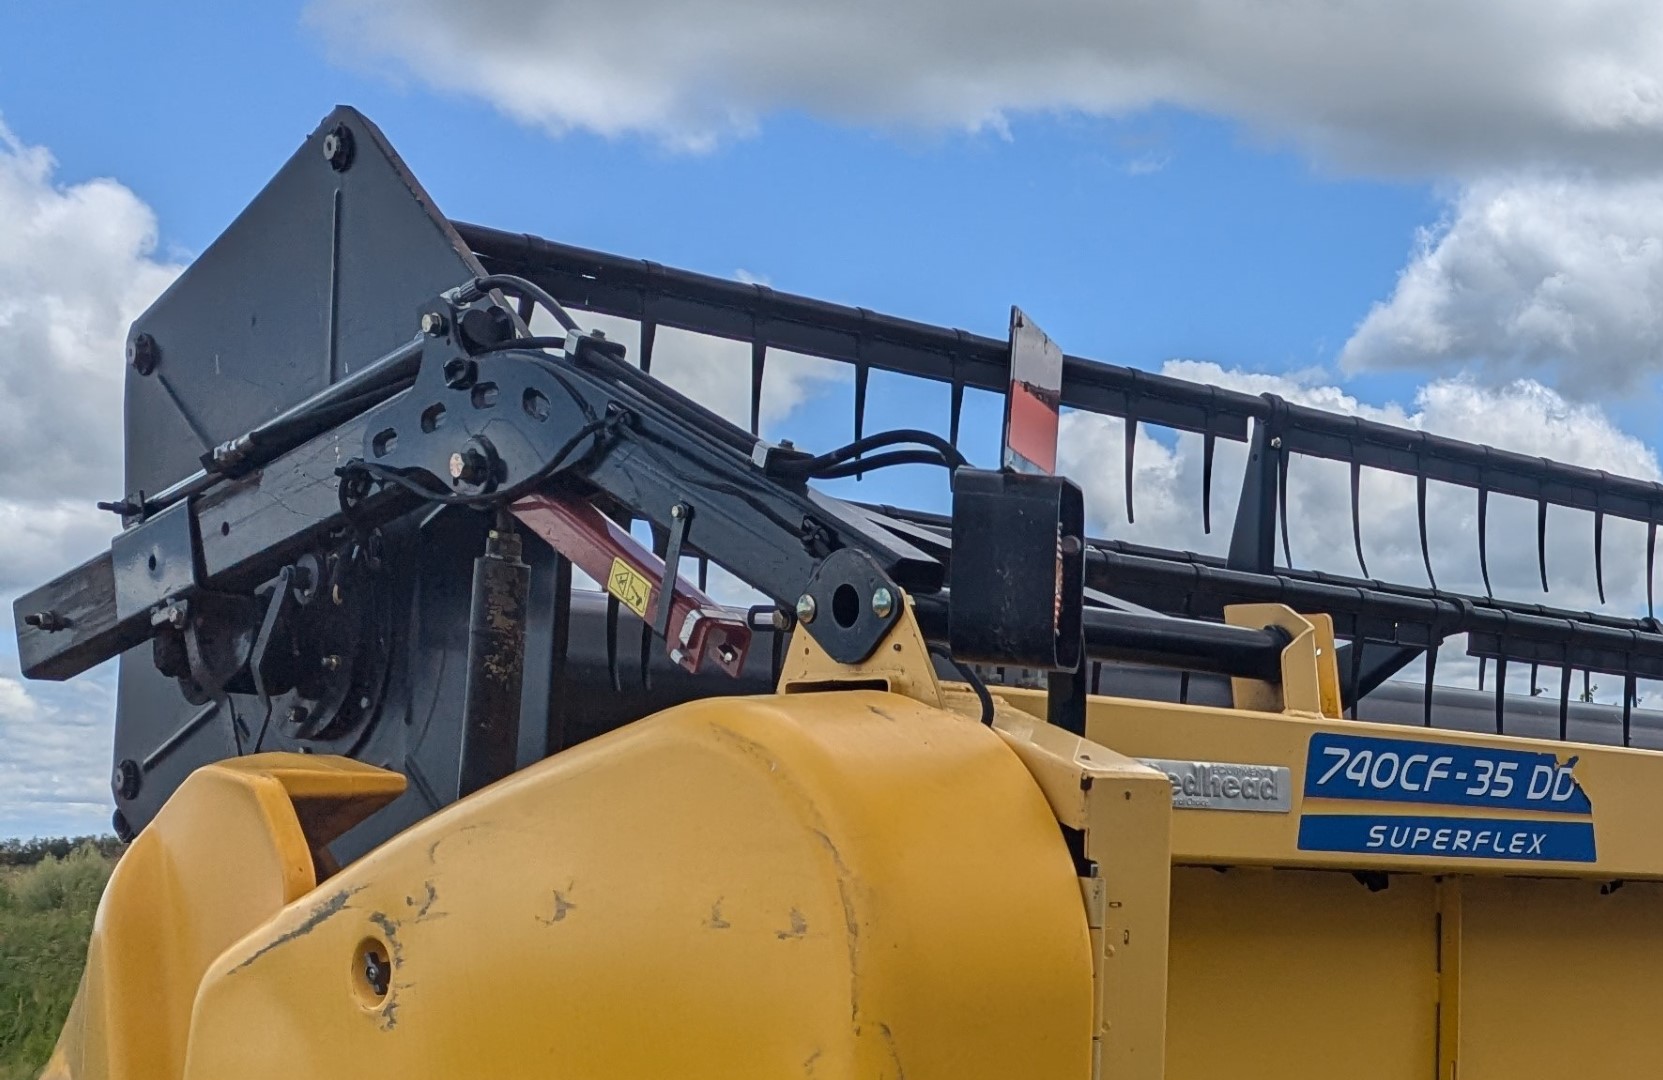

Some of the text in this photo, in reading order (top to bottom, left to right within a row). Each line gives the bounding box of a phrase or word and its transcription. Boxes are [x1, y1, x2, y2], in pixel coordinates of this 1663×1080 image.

[1146, 762, 1279, 800] edhead
[1316, 746, 1519, 799] 740CF-35
[1366, 824, 1547, 855] SUPERFLEX
